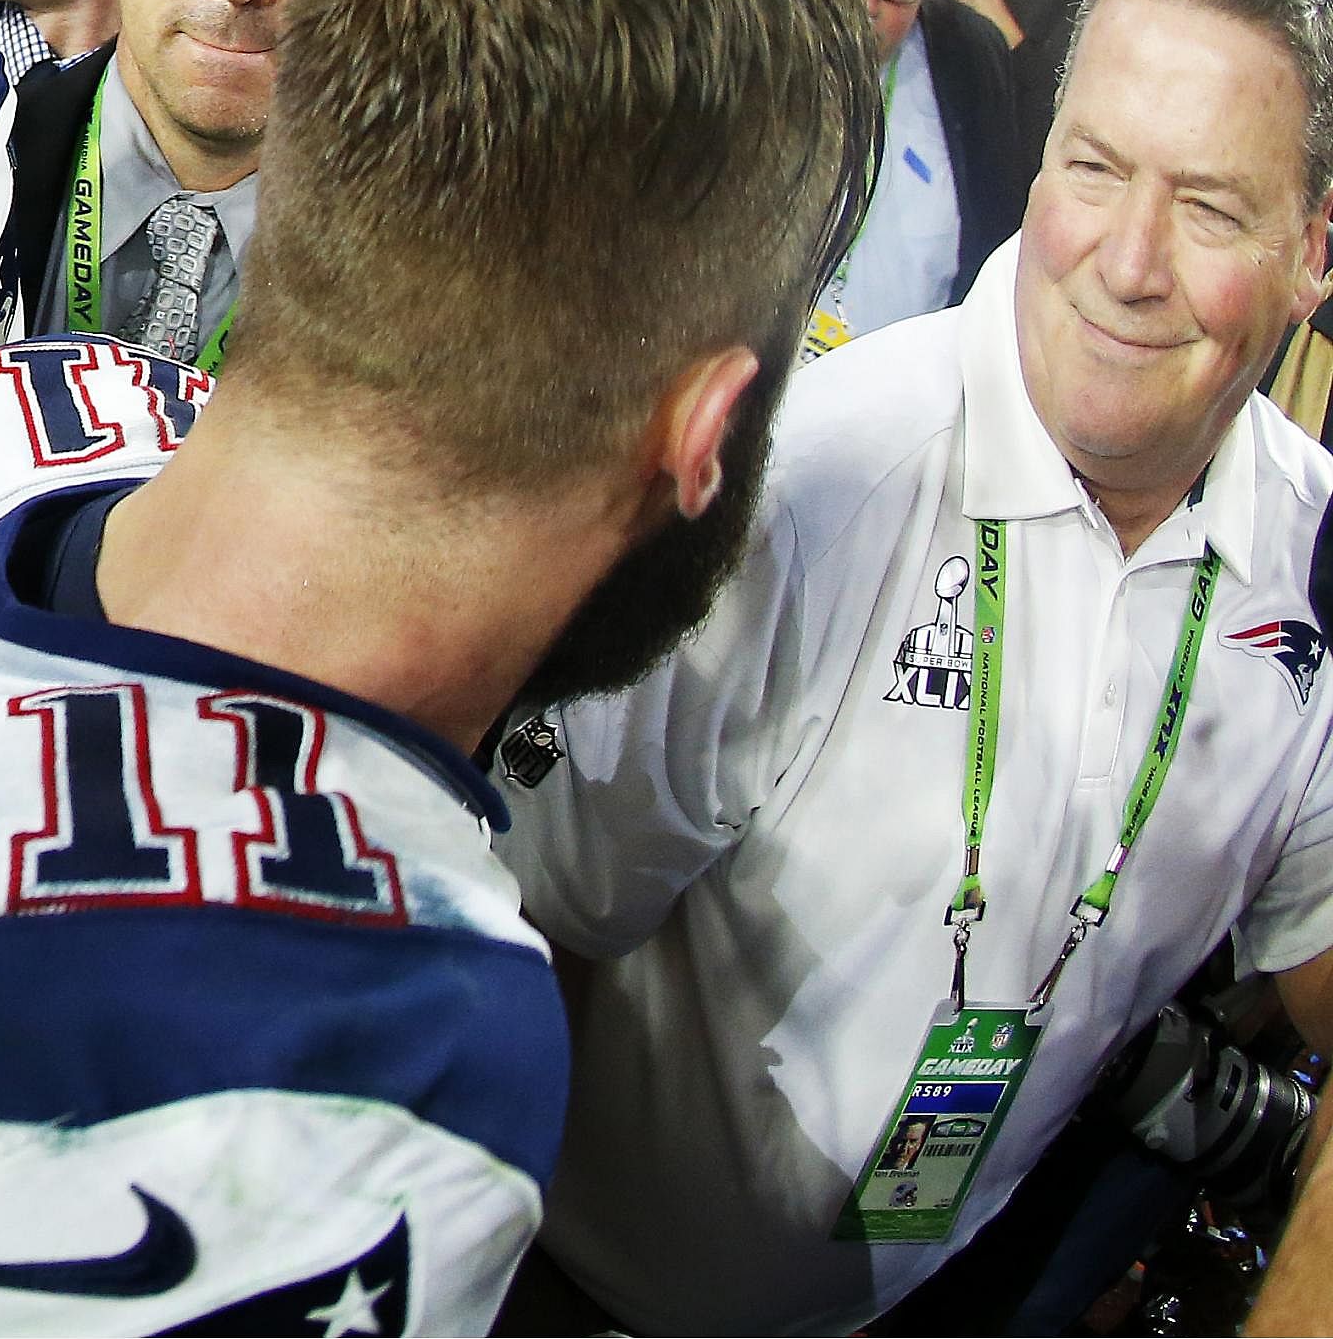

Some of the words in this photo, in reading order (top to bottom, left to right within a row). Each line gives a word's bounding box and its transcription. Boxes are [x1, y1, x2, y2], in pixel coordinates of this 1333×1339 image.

[72, 178, 93, 325] GAMEDAY
[883, 663, 972, 711] XLI
[946, 657, 970, 669] BOW
[981, 652, 990, 719] NATIONAL
[1141, 765, 1158, 798] BOWL
[1178, 628, 1196, 683] ARIZONA
[973, 722, 987, 784] FOOTBALL
[6, 683, 408, 927] 11
[911, 1085, 953, 1098] RS89
[916, 1057, 1023, 1077] GAMEDAY
